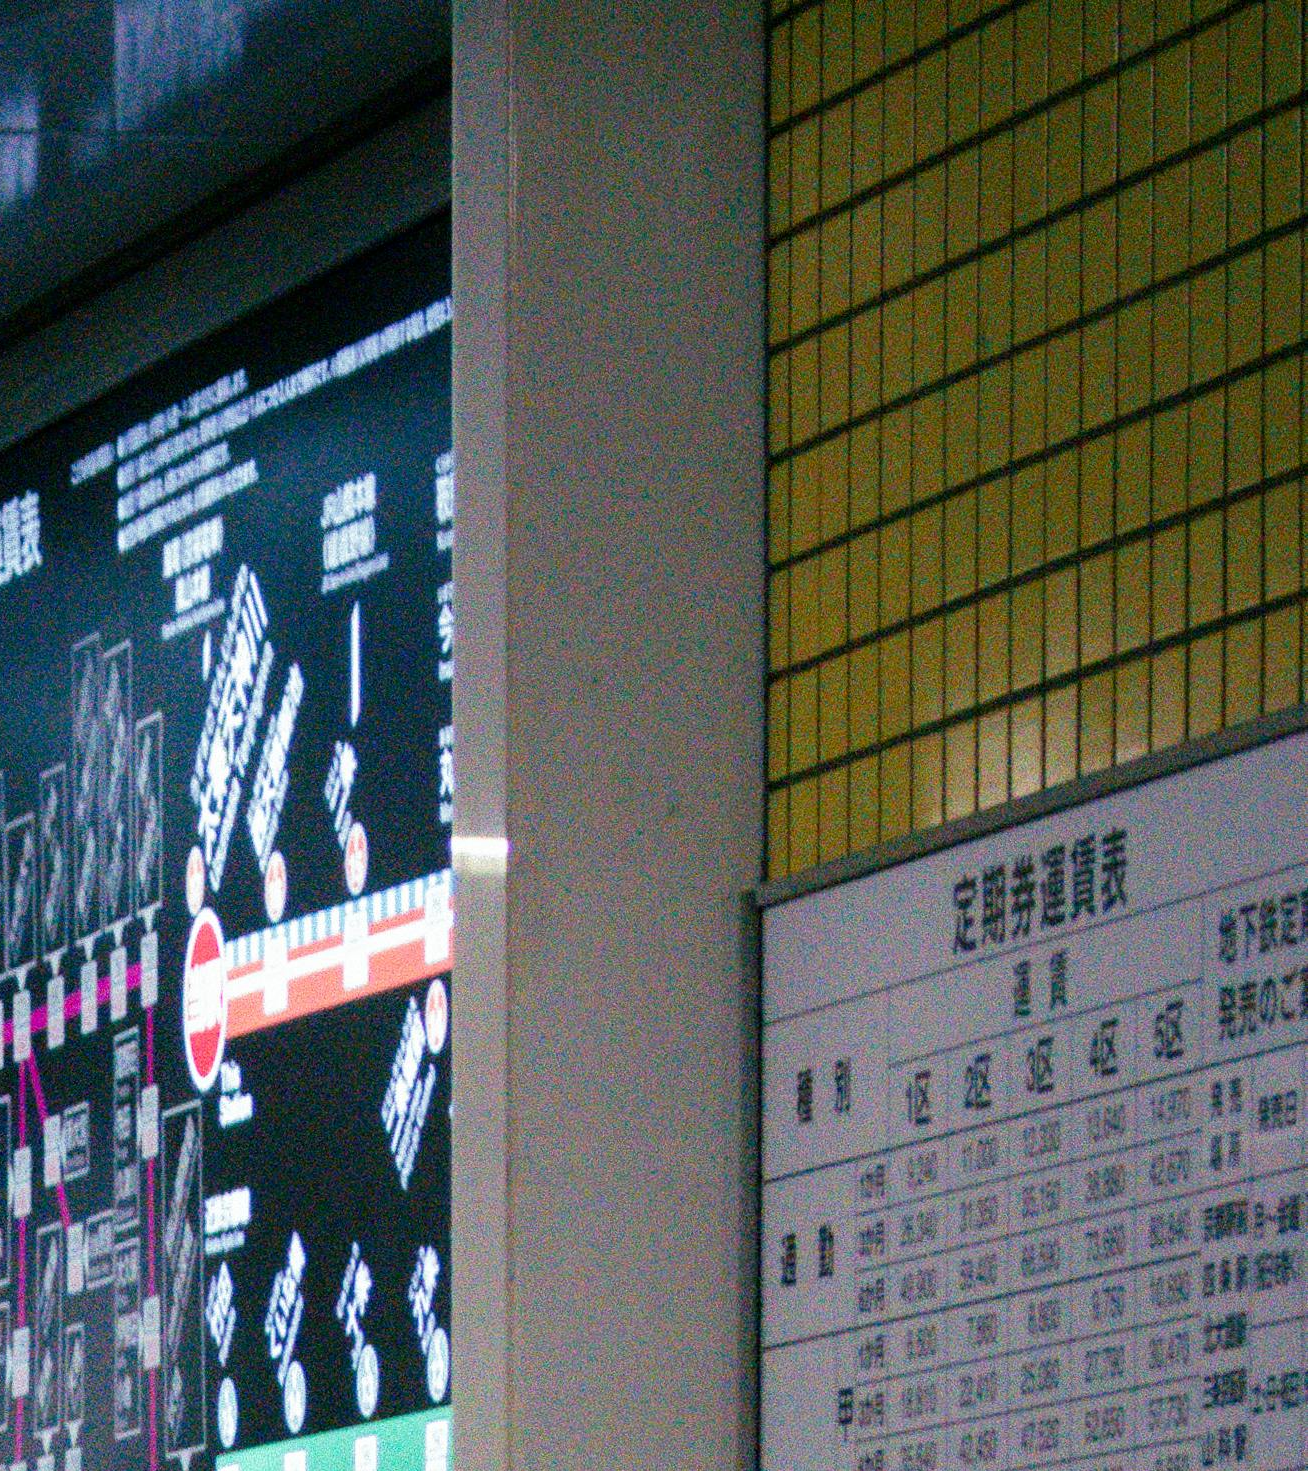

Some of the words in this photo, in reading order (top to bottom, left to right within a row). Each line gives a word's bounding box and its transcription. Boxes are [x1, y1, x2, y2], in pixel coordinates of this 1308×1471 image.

[953, 829, 1128, 953] 定期券運賃表
